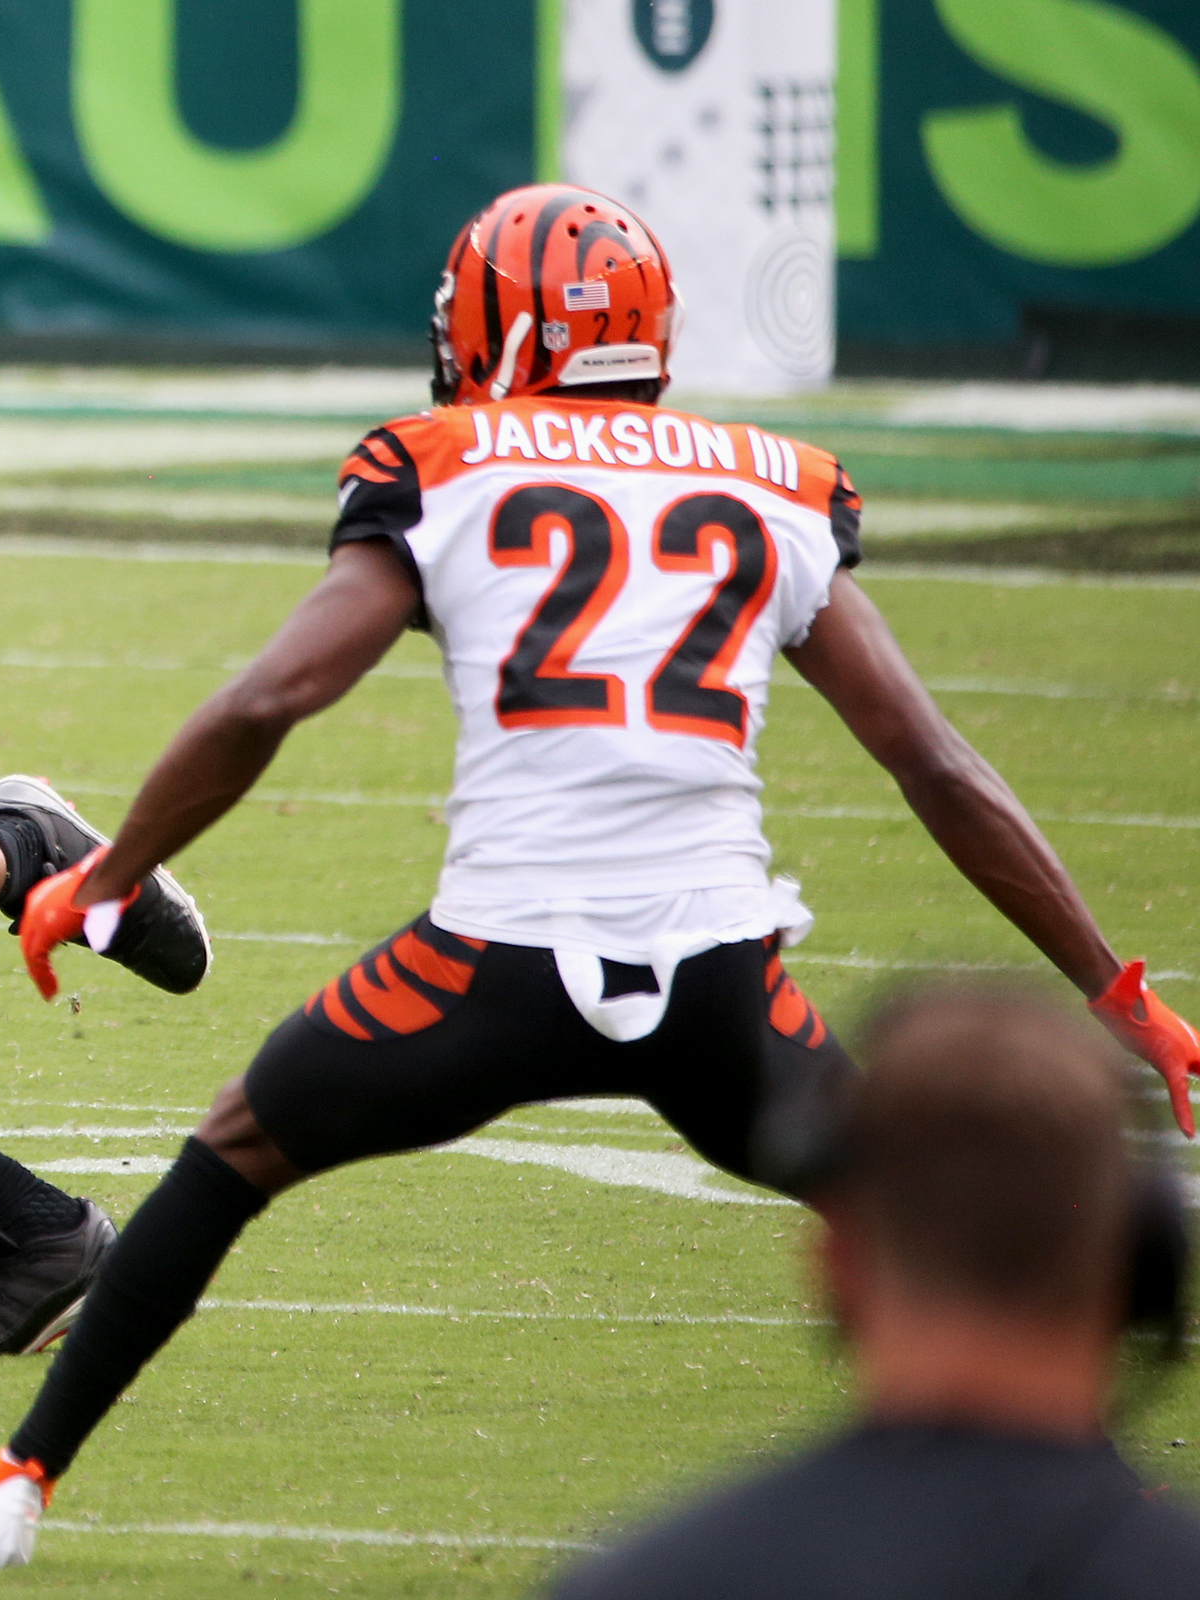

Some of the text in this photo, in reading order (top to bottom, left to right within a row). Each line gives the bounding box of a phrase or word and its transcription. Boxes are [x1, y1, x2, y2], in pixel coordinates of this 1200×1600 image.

[462, 412, 799, 491] JACKSON III
[489, 481, 779, 752] 22
